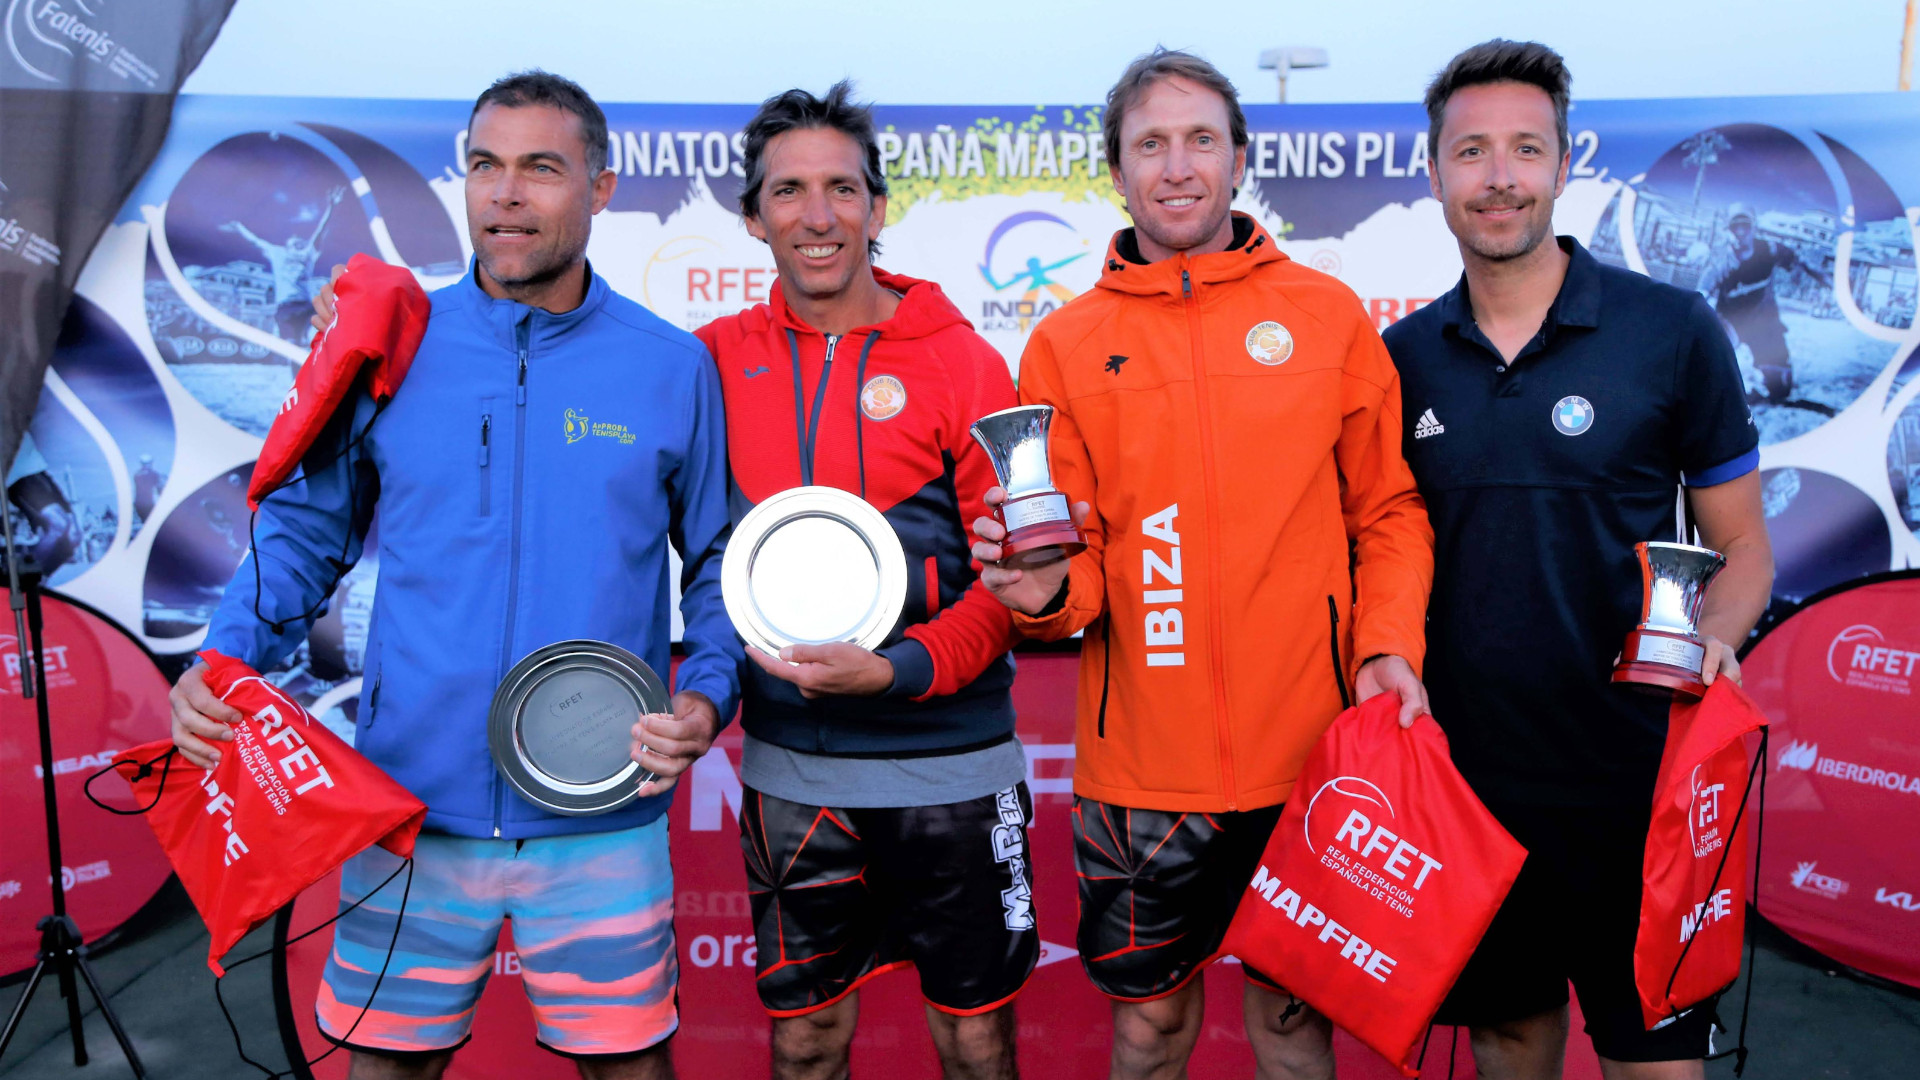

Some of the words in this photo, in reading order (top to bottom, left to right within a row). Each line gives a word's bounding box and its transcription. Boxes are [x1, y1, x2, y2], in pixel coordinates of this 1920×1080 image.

[37, 1, 115, 57] Fatenis
[878, 124, 986, 178] PAÑA
[1258, 322, 1279, 331] TENIS
[1414, 424, 1445, 439] adidas
[1557, 397, 1591, 412] BMW
[1142, 502, 1185, 667] IBIZA
[1851, 644, 1920, 677] RFET
[558, 692, 583, 711] RFET
[251, 743, 292, 804] FEDERACIÓN
[253, 704, 335, 796] RFET
[1816, 756, 1920, 796] IBERDROLA
[255, 774, 266, 793] DE
[263, 787, 287, 816] TENIS
[1325, 845, 1350, 867] REAL
[1353, 862, 1414, 905] FEDERACIÓN
[1334, 808, 1443, 891] RFET
[1319, 855, 1369, 894] ESPAÑOLA
[1370, 886, 1384, 901] DE
[1385, 894, 1414, 919] TENIS
[1250, 864, 1398, 983] MAPFRE
